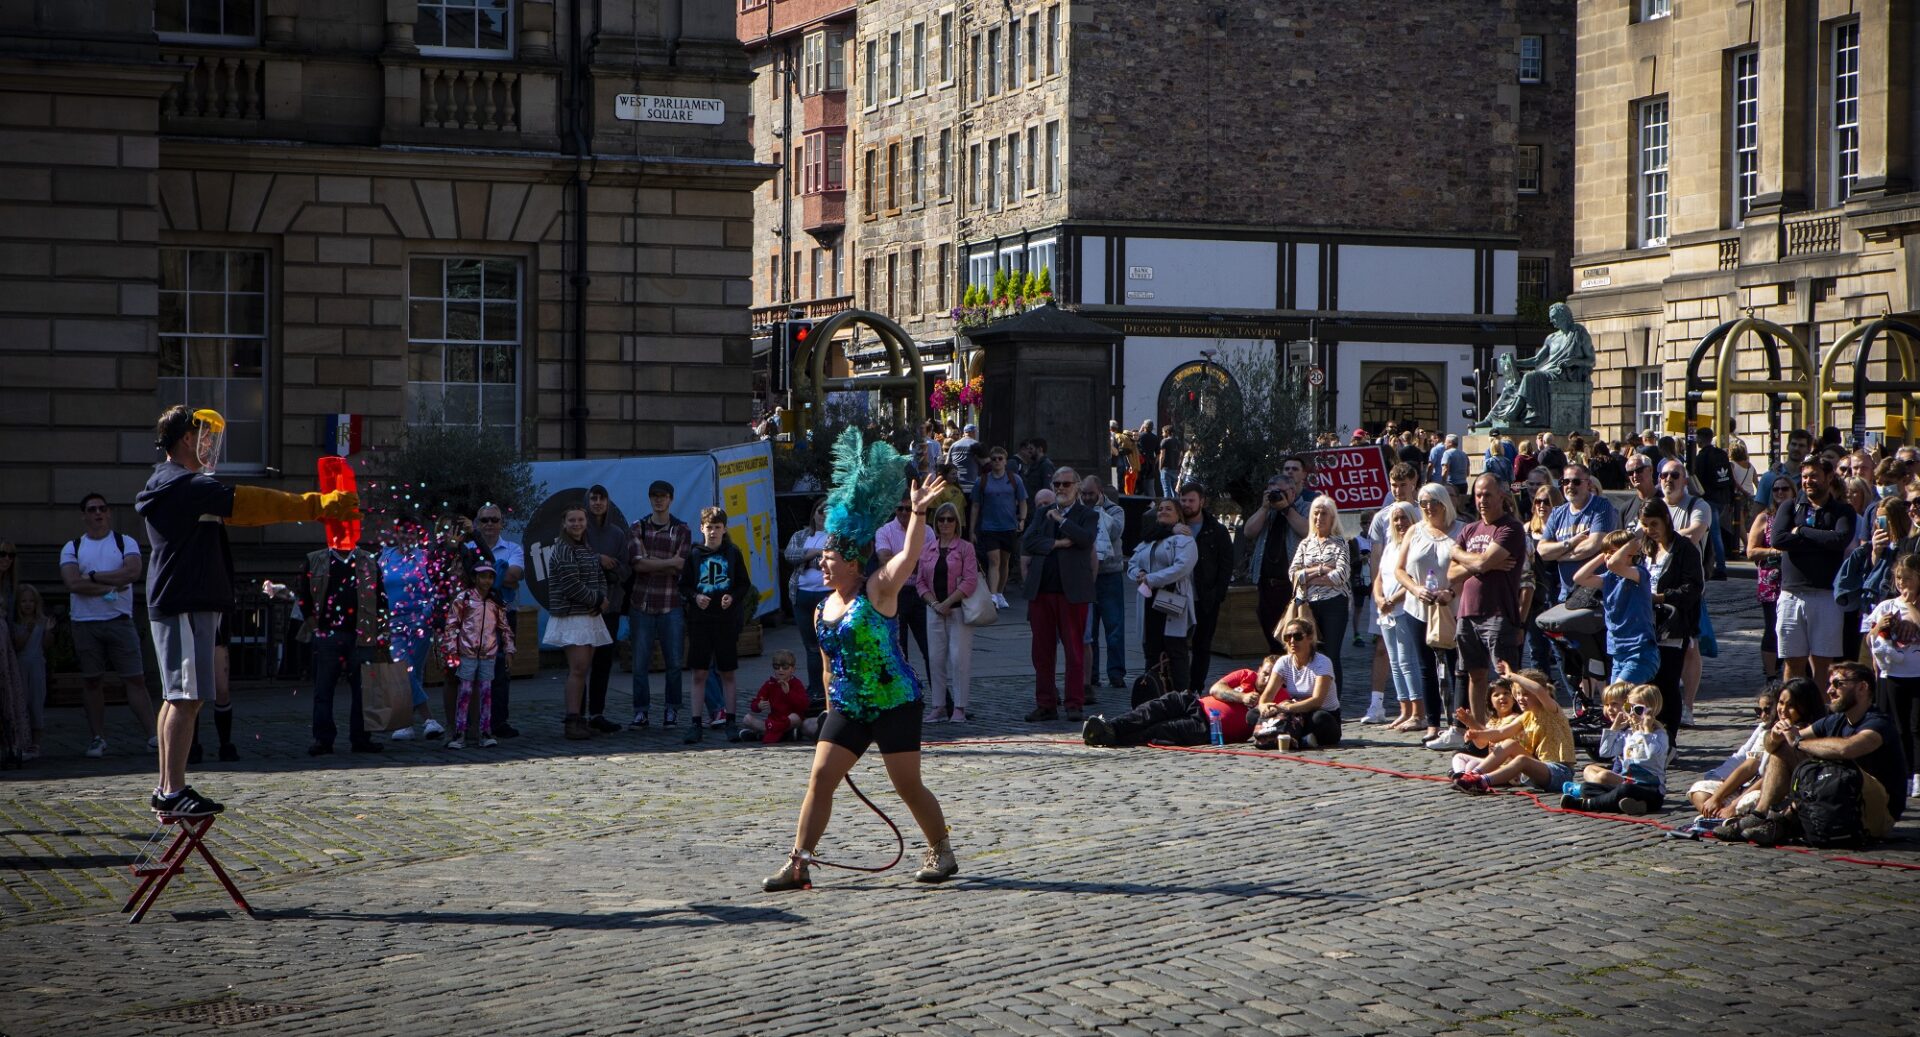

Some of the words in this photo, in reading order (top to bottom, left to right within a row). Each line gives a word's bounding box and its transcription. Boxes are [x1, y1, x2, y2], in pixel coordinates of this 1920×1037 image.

[619, 96, 648, 108] WEST
[654, 98, 721, 111] PARLIAMENT
[647, 108, 693, 121] SQUARE
[1124, 324, 1171, 334] DEACON
[1237, 326, 1281, 336] TAVERN
[1311, 373, 1322, 381] 20
[1307, 472, 1333, 487] ON
[1339, 468, 1379, 485] LEFT
